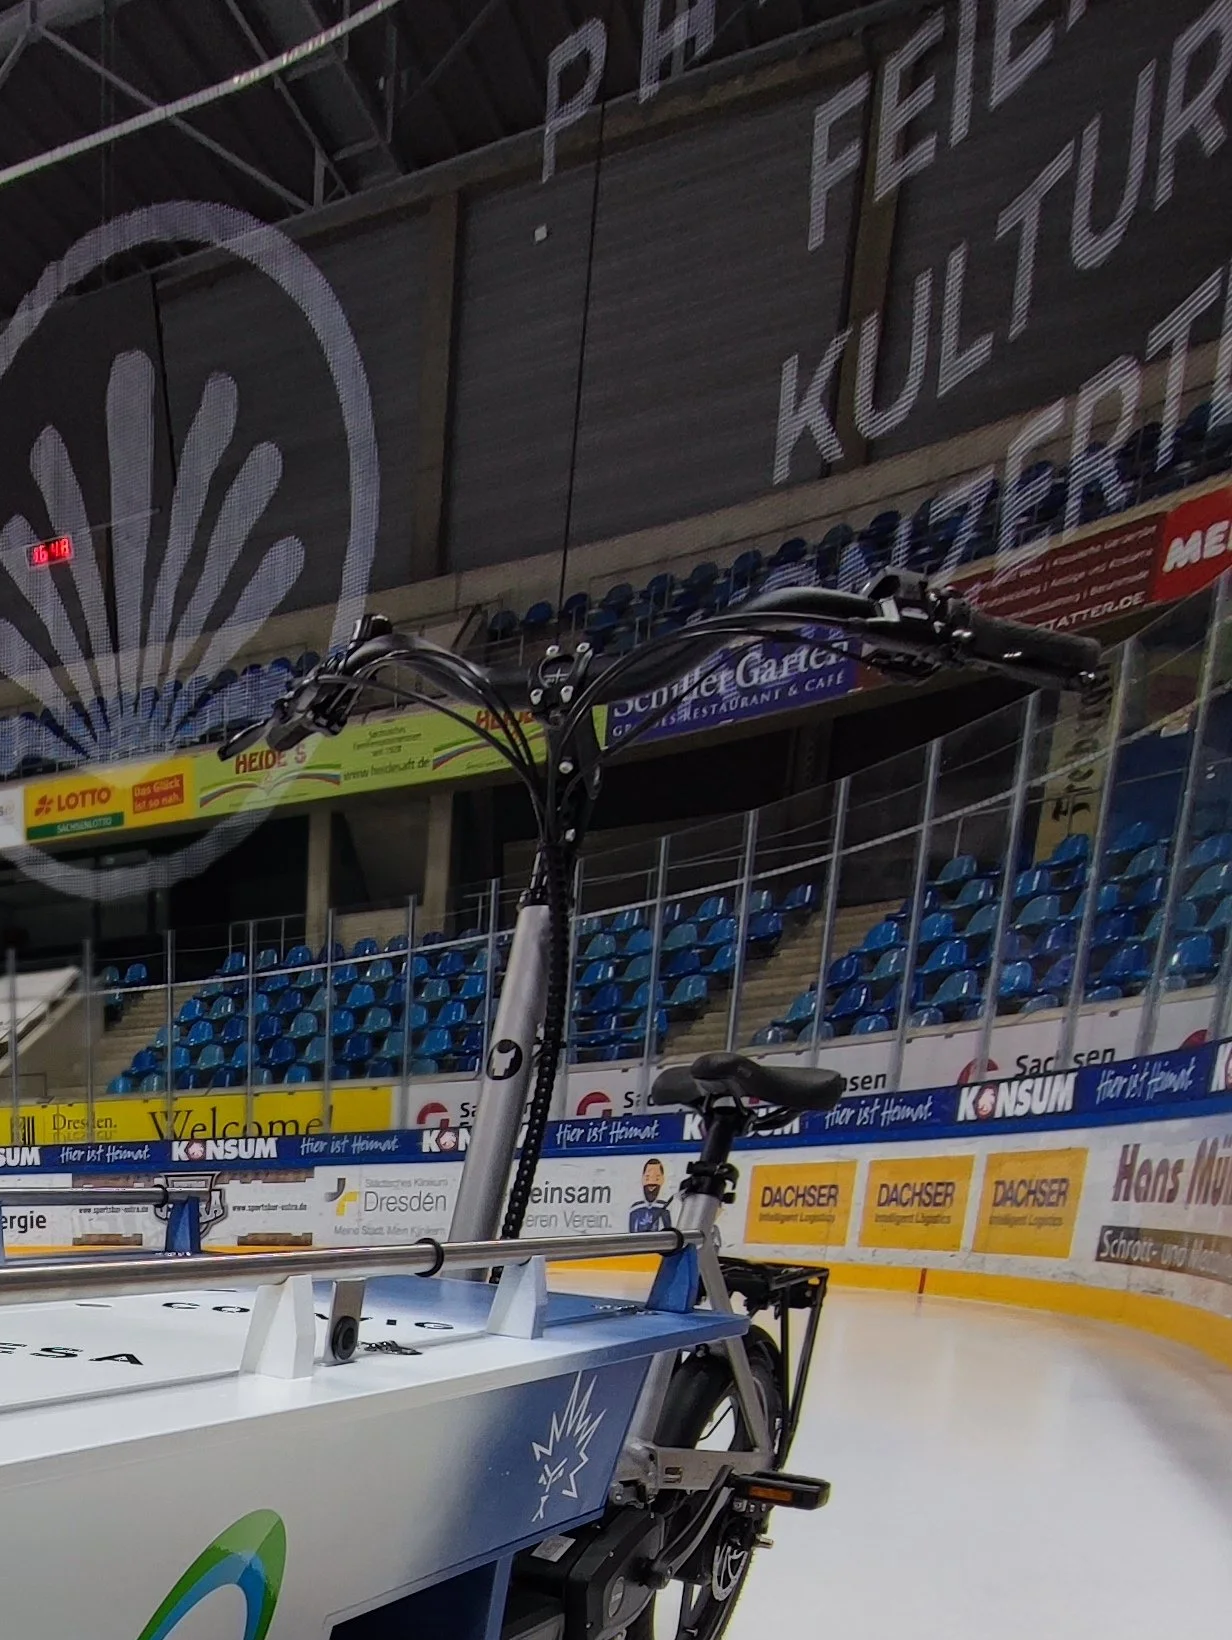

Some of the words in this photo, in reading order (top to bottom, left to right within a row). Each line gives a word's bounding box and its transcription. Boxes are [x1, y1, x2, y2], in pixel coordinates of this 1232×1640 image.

[808, 0, 1086, 251] FEIE
[1162, 520, 1232, 573] ME
[57, 787, 112, 812] LOTTO
[1096, 1067, 1126, 1104] Hier
[825, 1102, 855, 1130] Hier
[300, 1137, 328, 1156] Hier
[556, 1122, 583, 1146] Hier
[59, 1145, 85, 1164] Hier
[1111, 1142, 1185, 1204] Hans
[530, 1180, 612, 1204] einsam
[760, 1183, 840, 1209] DACHSER
[877, 1181, 956, 1208] DACHSER
[991, 1176, 1071, 1208] DACHSER
[1, 1210, 48, 1235] ergie
[525, 1213, 558, 1228] eren
[563, 1209, 613, 1229] Verein.
